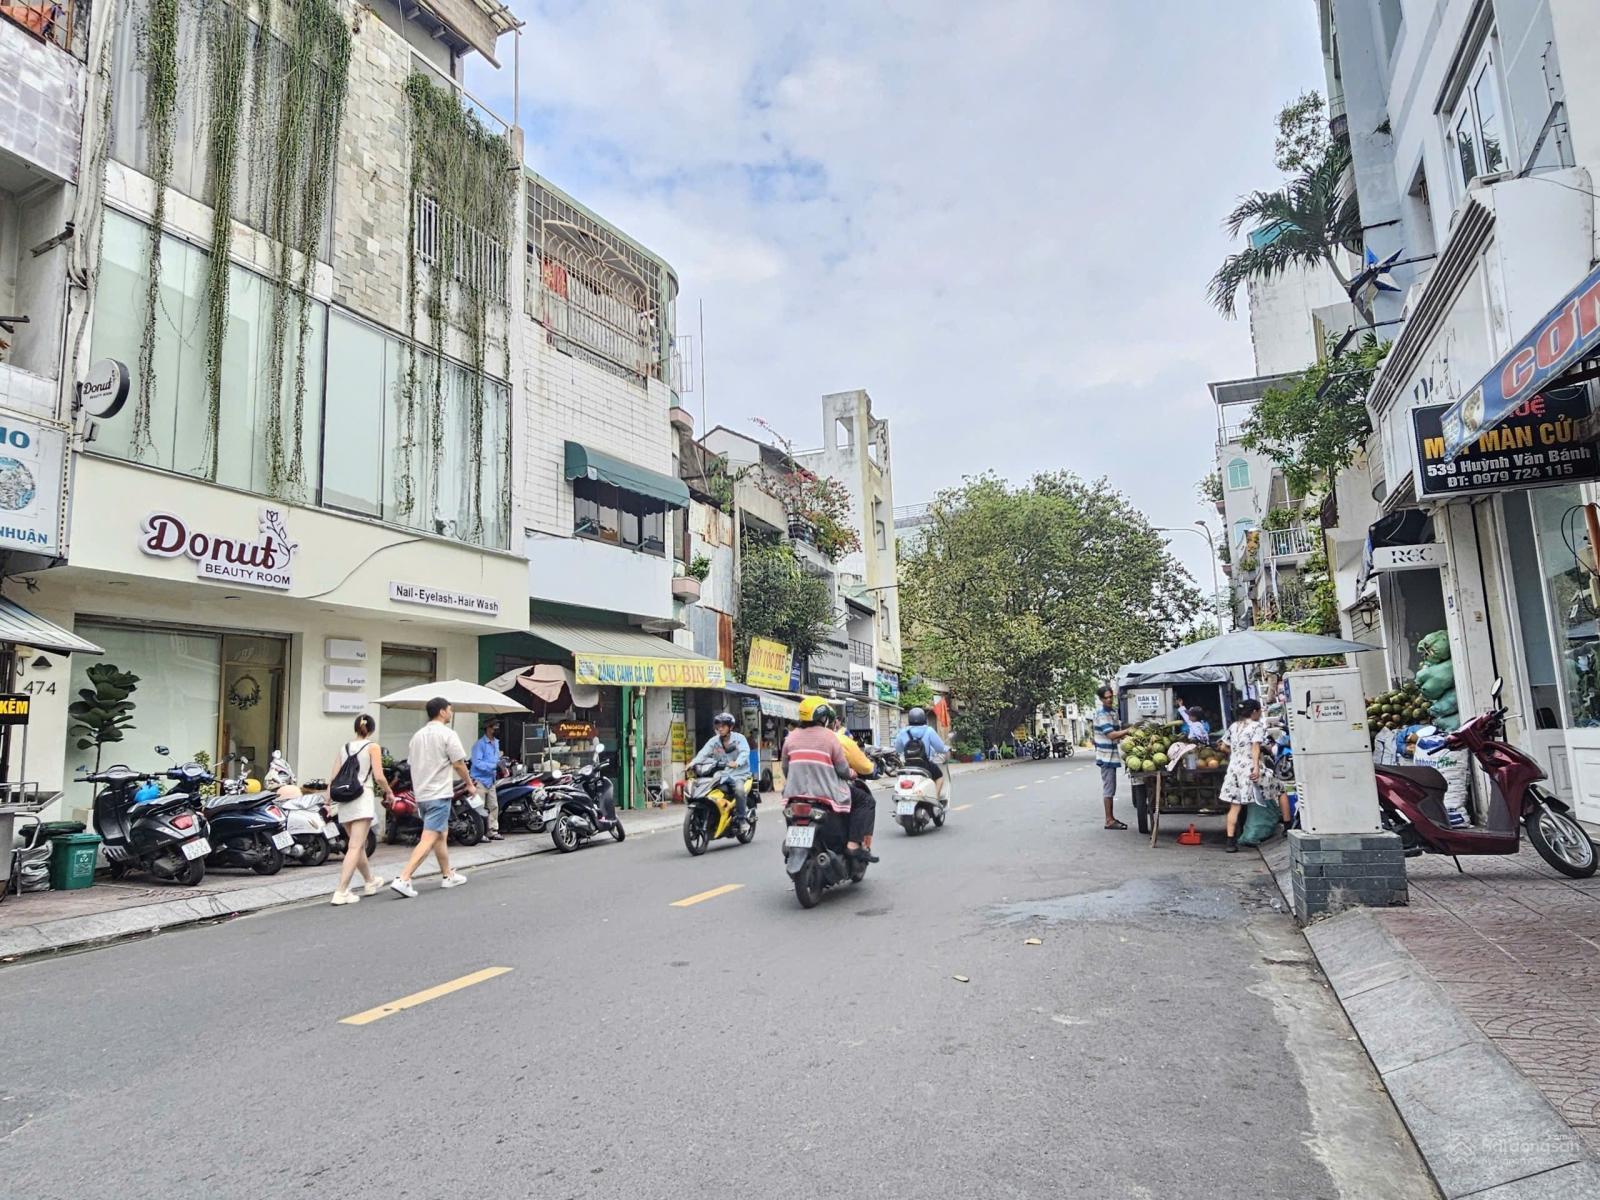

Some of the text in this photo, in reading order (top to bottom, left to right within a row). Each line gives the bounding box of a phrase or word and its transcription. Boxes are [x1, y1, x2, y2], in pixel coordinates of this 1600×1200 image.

[83, 377, 112, 395] Donut
[1480, 424, 1533, 453] MÀN
[1427, 447, 1591, 477] 539 Huỳnh Văn Bánh
[1447, 464, 1574, 488] ĐT: 0979 724 115
[147, 514, 277, 570] Donut
[205, 563, 290, 585] BEAUTY ROOM
[396, 584, 414, 598] Nail
[419, 589, 453, 604] Eyelash
[457, 595, 475, 607] Hair
[476, 599, 499, 612] Wash
[657, 664, 677, 683] CU
[681, 665, 705, 683] BIN
[23, 681, 56, 695] 474
